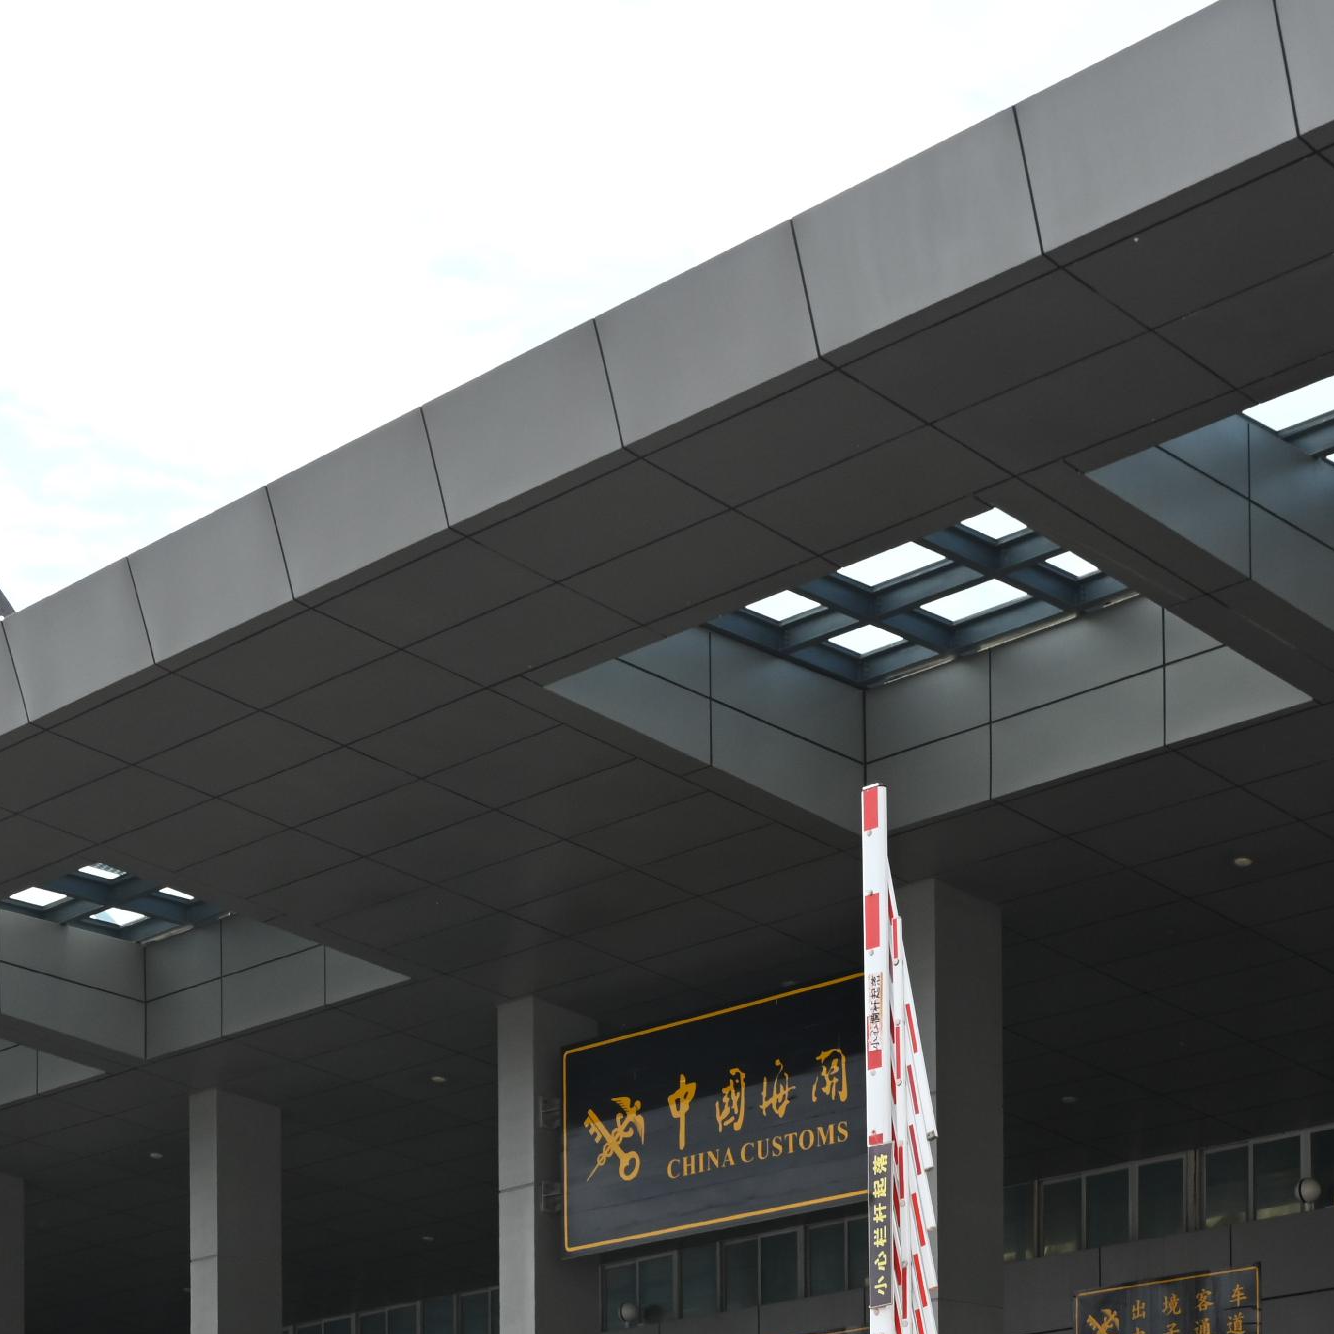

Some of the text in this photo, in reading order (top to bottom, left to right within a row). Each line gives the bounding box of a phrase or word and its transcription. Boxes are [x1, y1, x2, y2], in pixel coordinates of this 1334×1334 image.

[667, 1121, 849, 1179] CHINA CUSTOMS
[872, 1153, 888, 1296] 小心栏杆起落
[1131, 1283, 1248, 1321] 出境客车
